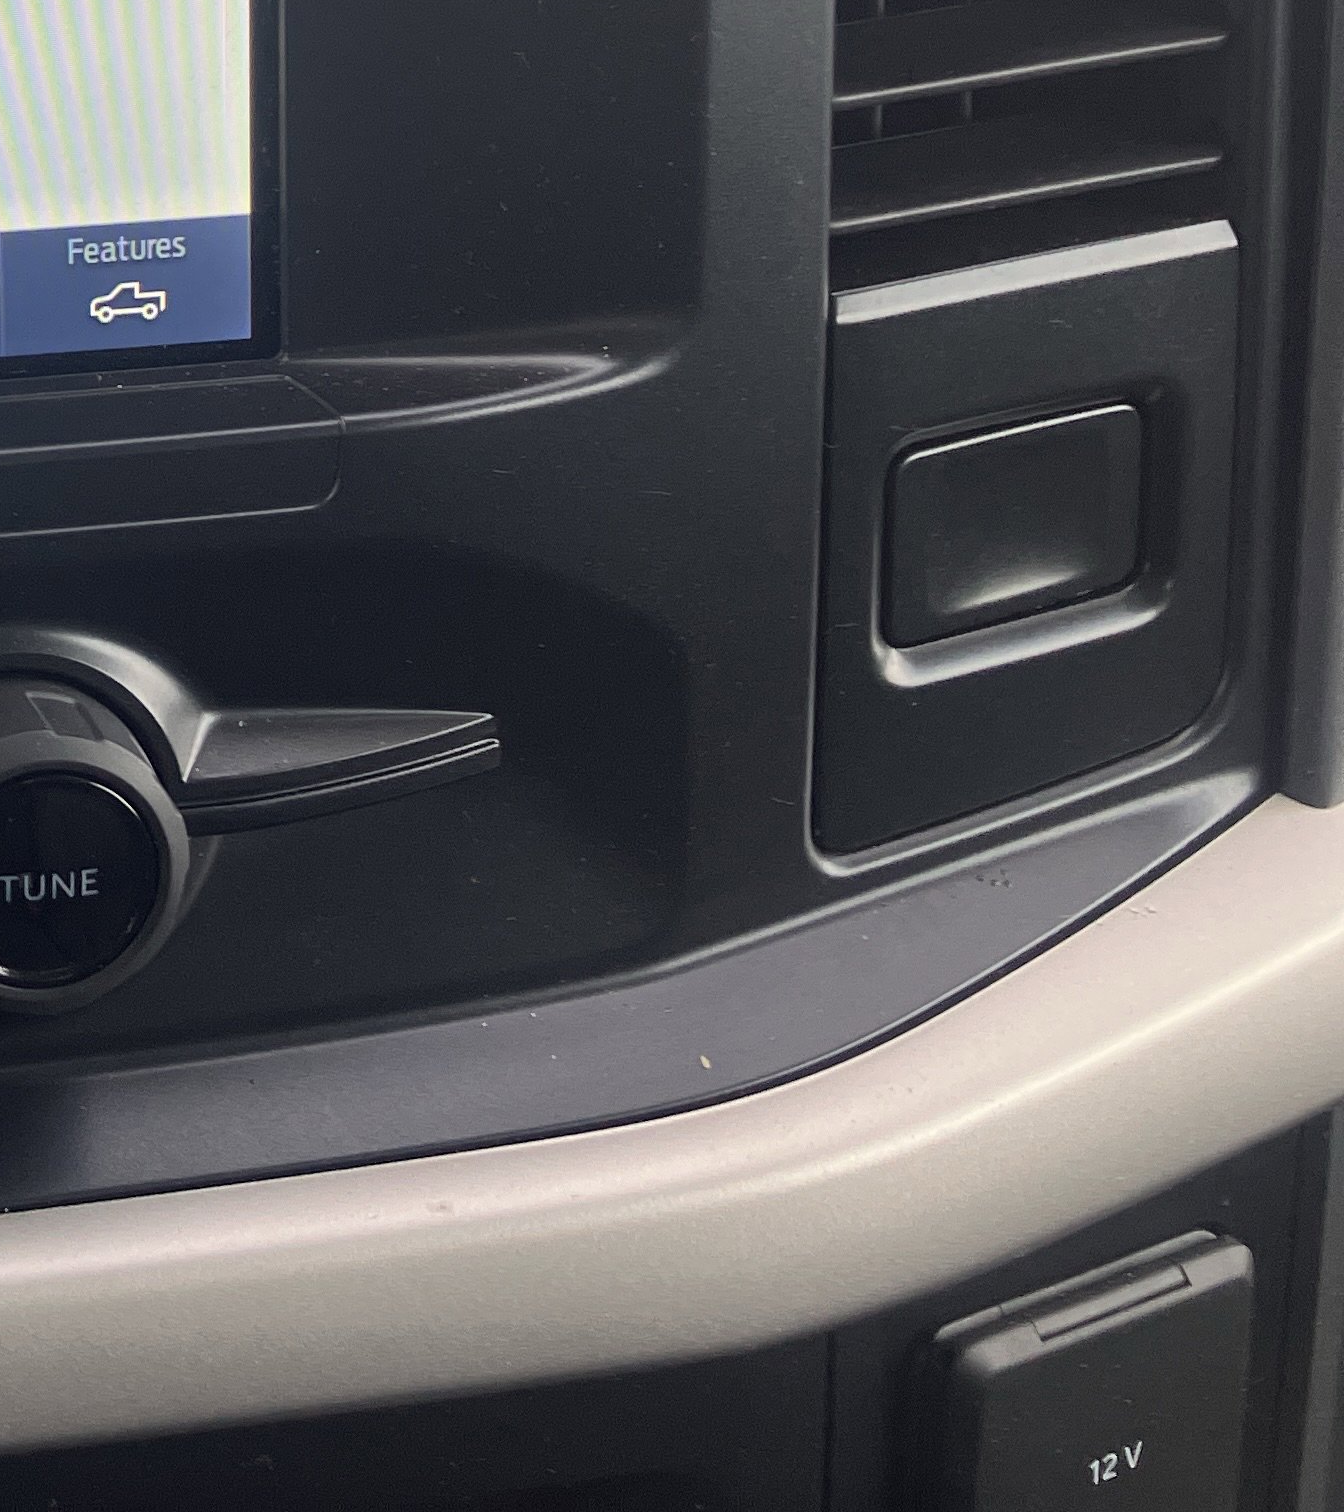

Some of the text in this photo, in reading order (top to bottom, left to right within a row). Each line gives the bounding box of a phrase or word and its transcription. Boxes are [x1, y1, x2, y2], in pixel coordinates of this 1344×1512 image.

[66, 232, 187, 266] Features
[1088, 1440, 1144, 1485] 12 V
